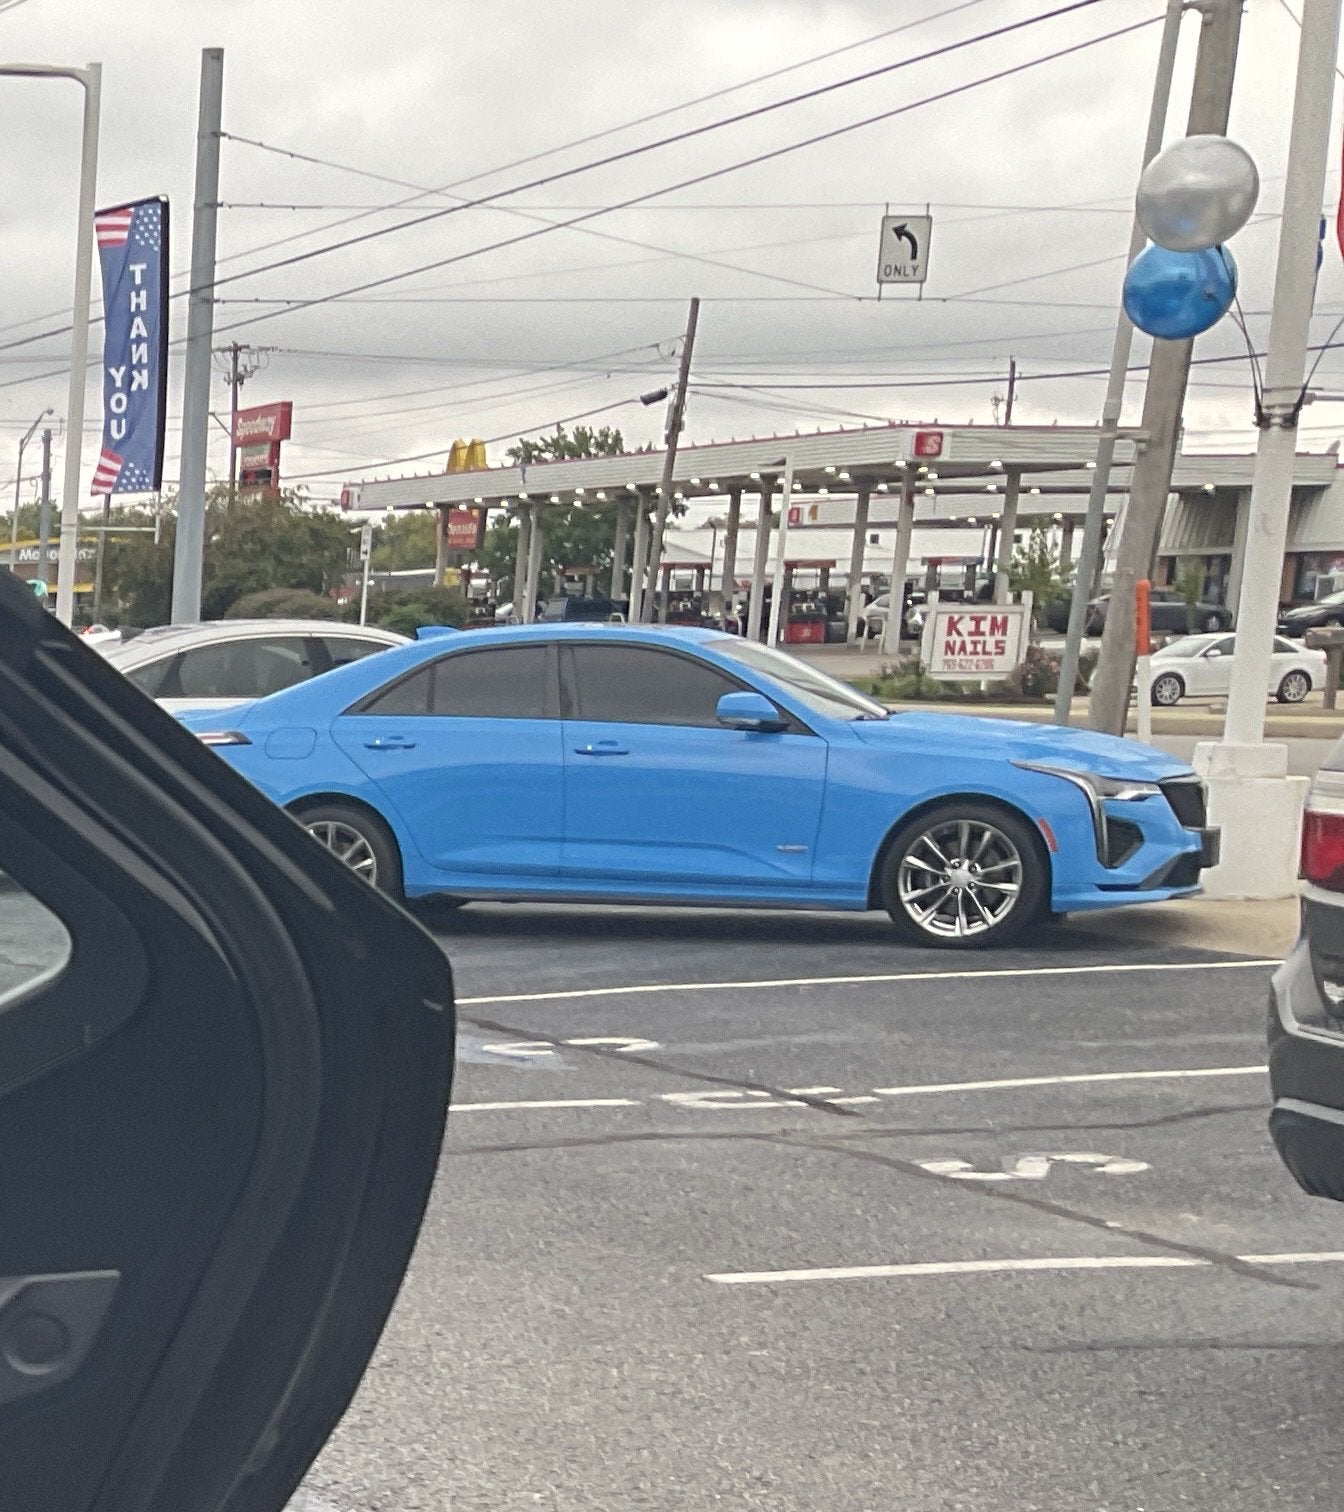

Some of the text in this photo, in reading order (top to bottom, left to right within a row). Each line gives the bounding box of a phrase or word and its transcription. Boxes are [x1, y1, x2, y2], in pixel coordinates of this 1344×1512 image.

[884, 264, 919, 277] ONLY
[946, 615, 1009, 637] KIM
[944, 639, 1006, 656] NAILS
